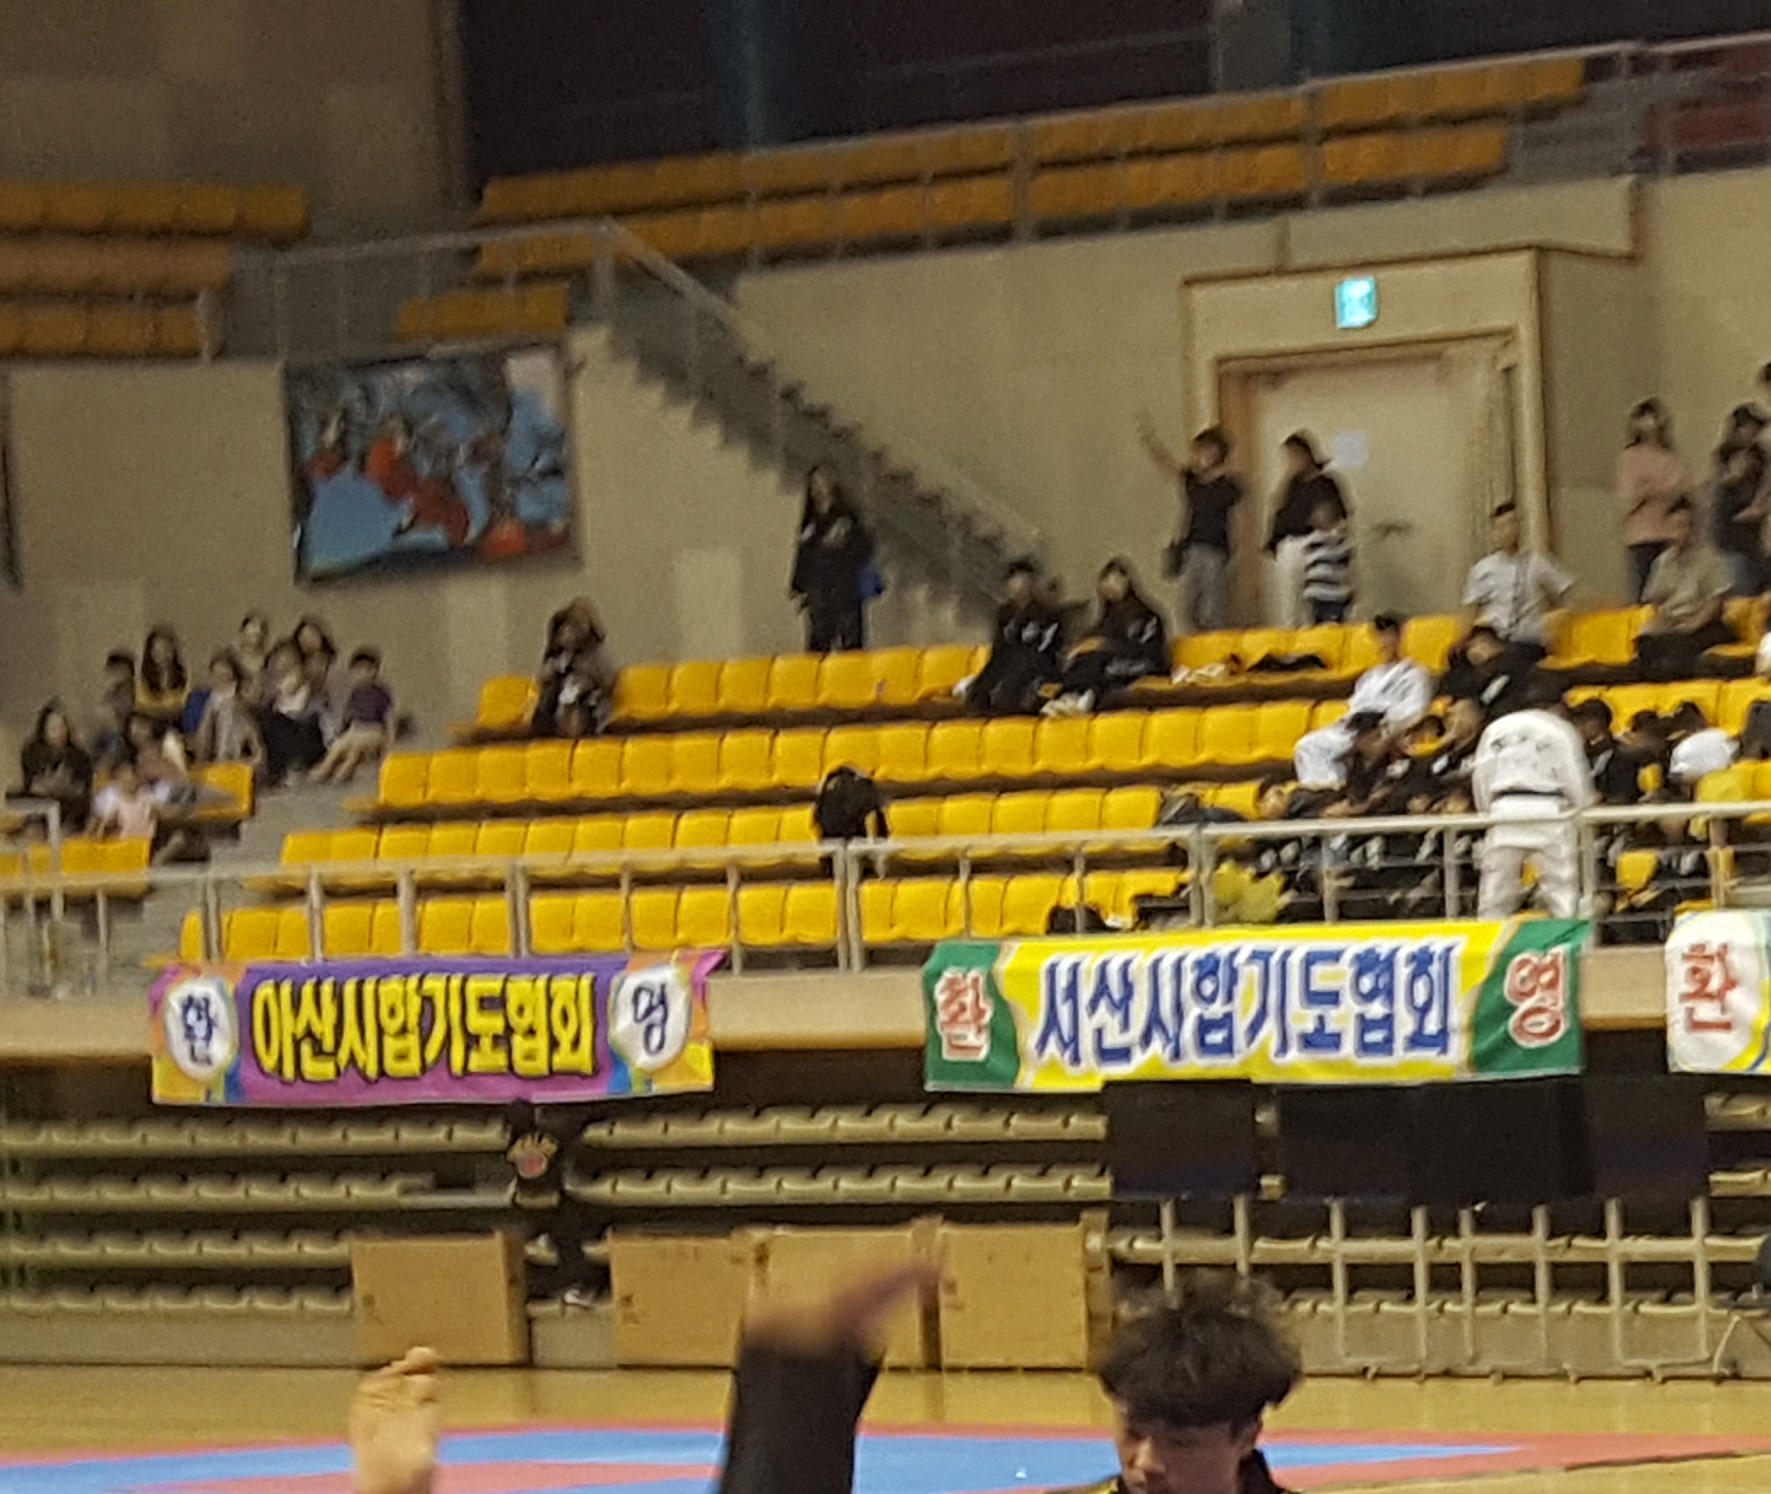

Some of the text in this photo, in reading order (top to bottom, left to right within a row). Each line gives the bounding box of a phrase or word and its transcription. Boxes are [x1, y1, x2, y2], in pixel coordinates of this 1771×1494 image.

[181, 972, 669, 1082] 환 아산시합기도협회 영
[937, 944, 1570, 1064] 환 서산시합기도협회 영
[1680, 942, 1737, 1031] 환
